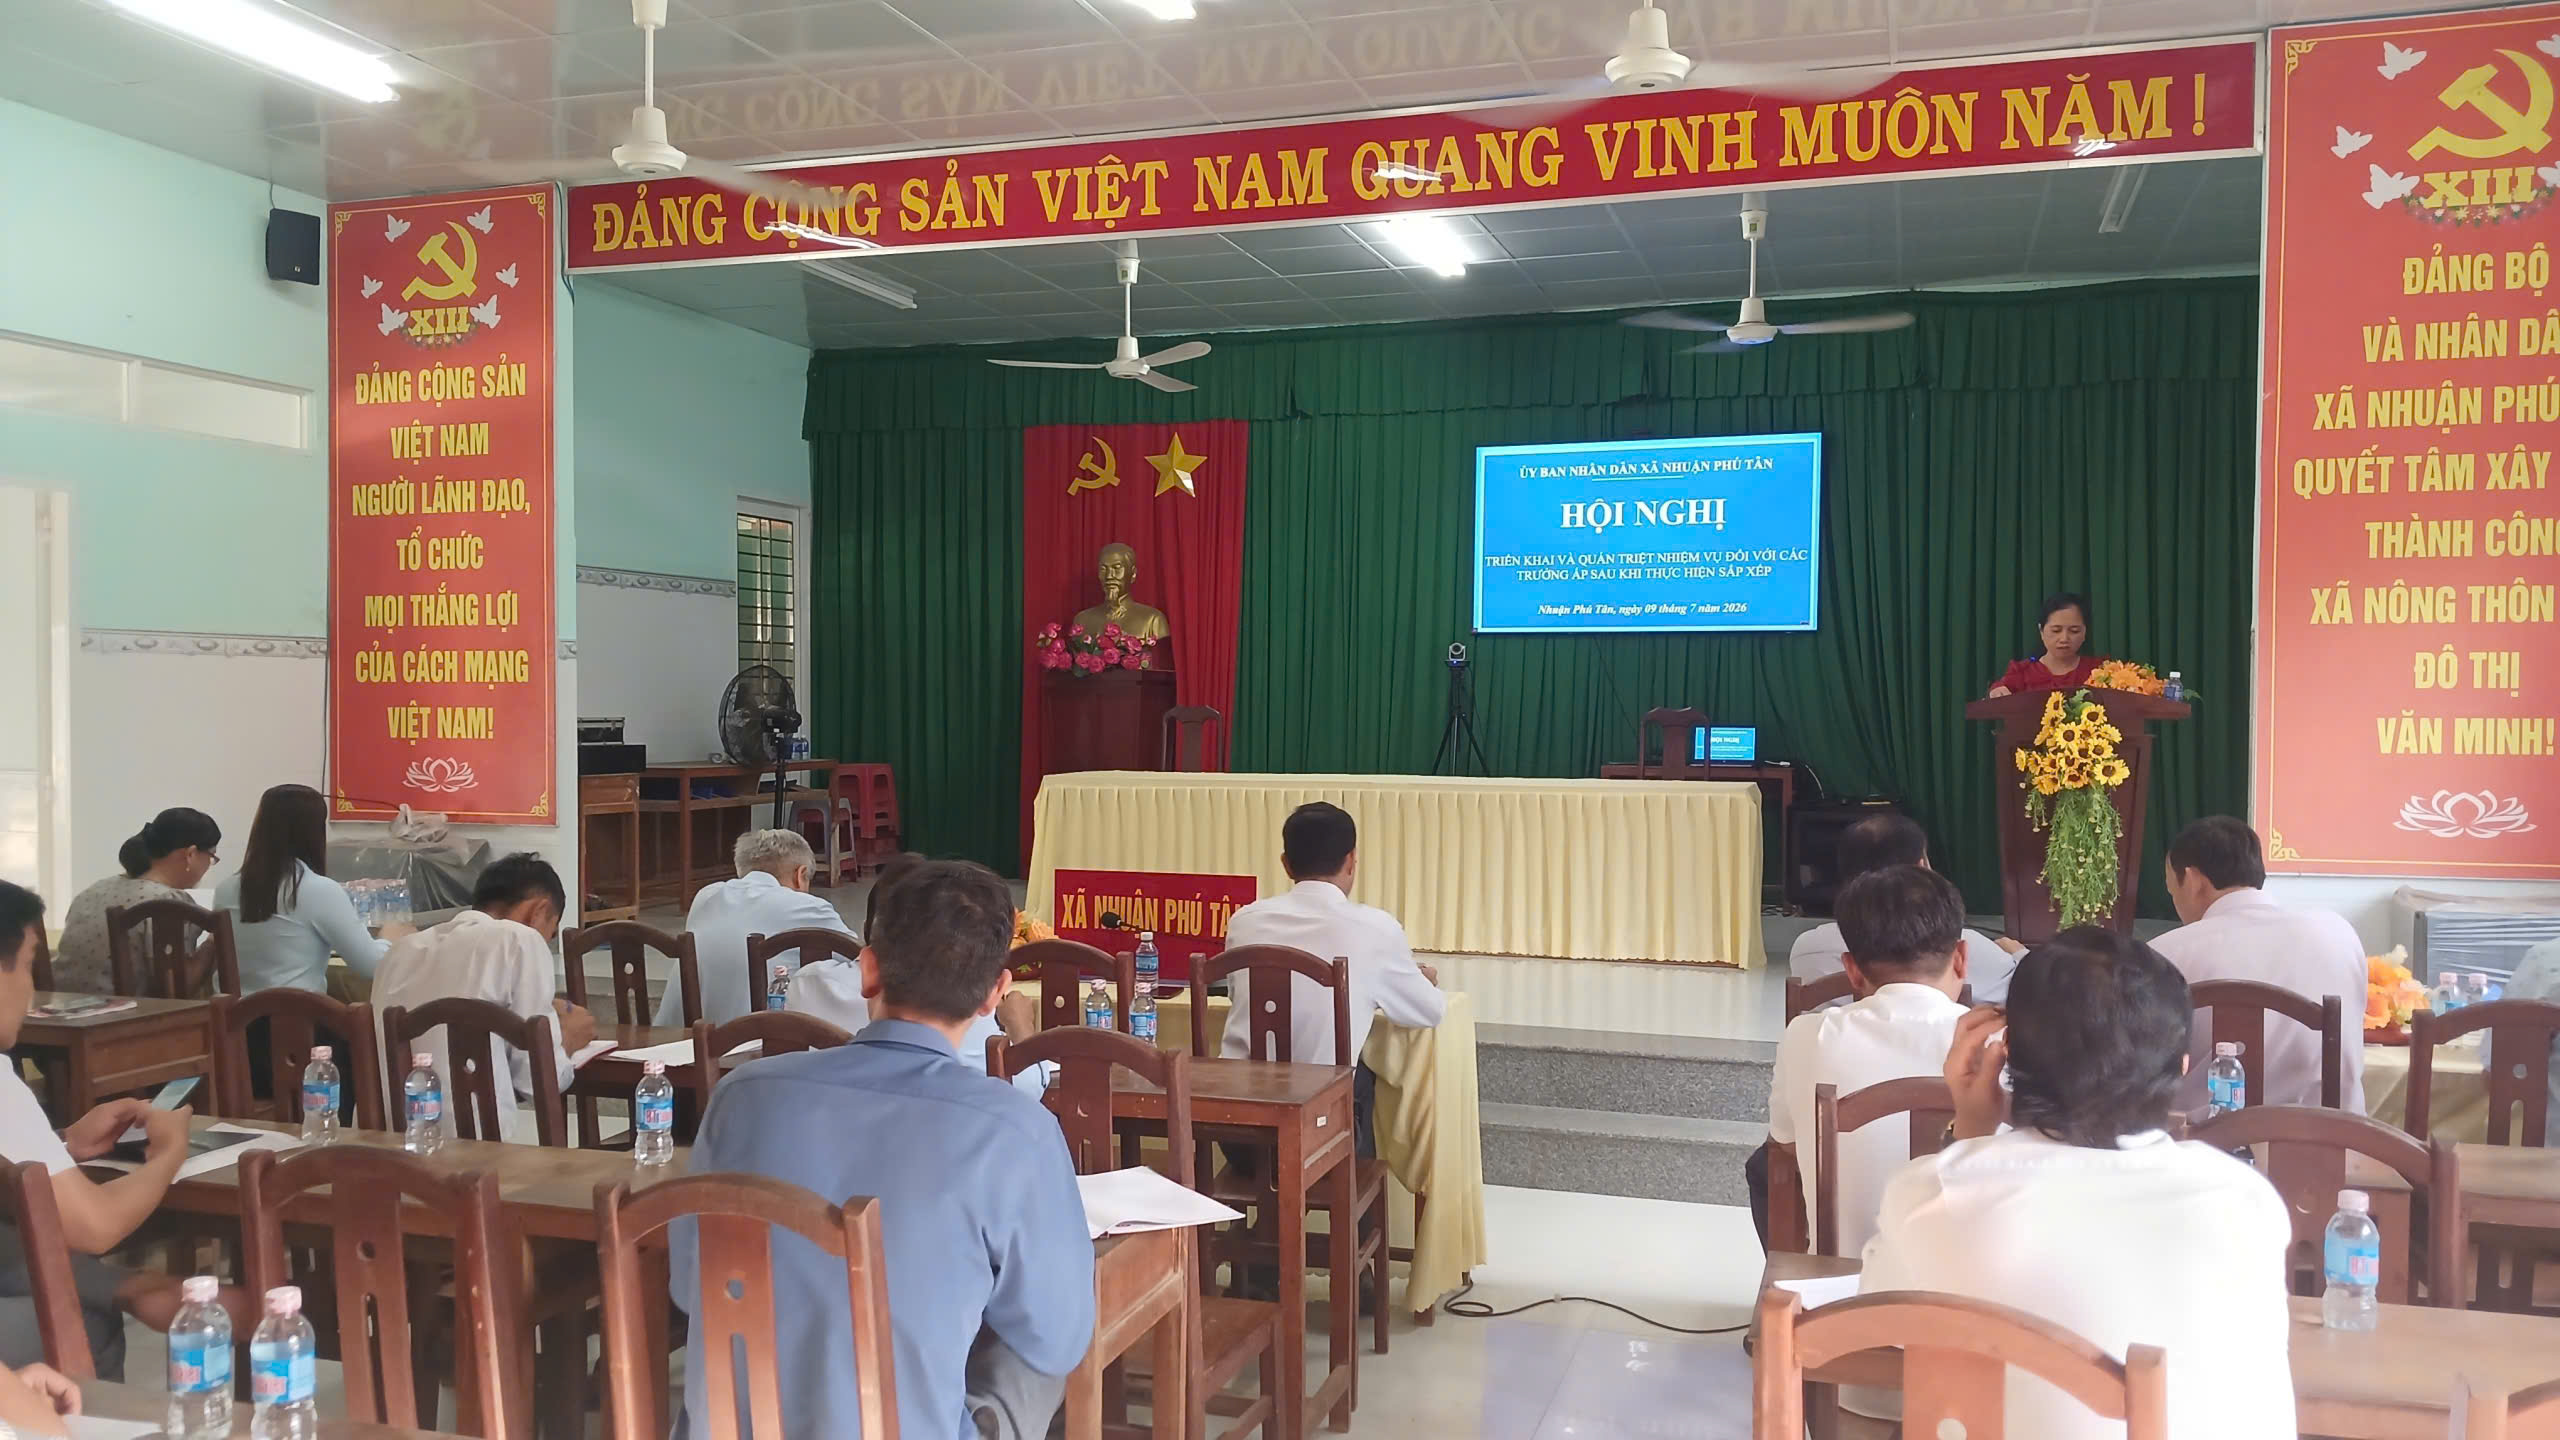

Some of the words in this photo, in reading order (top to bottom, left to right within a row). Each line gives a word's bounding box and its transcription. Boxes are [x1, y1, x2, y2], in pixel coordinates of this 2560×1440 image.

[593, 184, 727, 252] ĐẢNG
[744, 181, 881, 248] CỘNG
[899, 158, 1008, 232] SẢN
[1032, 154, 1168, 228] VIỆT
[1194, 148, 1328, 211] NAM
[1352, 127, 1564, 200] QUANG
[1585, 110, 1757, 181] VINH
[1779, 87, 1978, 167] MUÔN
[2001, 73, 2173, 150] NĂM
[2422, 166, 2536, 209] XIII
[2403, 243, 2494, 295] ĐẢNG
[2505, 241, 2549, 297] BỘ
[408, 306, 470, 336] XIII
[2362, 316, 2404, 363] VÀ
[2415, 312, 2508, 360] NHÂN
[355, 362, 411, 404] ĐẢNG
[418, 362, 475, 407] CỘNG
[482, 353, 526, 398] SẢN
[2313, 385, 2356, 431] XÃ
[2367, 379, 2482, 434] NHUẬN
[2493, 376, 2560, 424] PHÚ
[390, 419, 434, 465] VIỆT
[440, 423, 489, 457] NAM
[1540, 466, 1566, 478] BAN
[1569, 462, 1606, 476] NHÂN
[1609, 461, 1637, 474] DÂN
[1640, 460, 1659, 474] XÃ
[1662, 460, 1711, 474] NHUẬN
[1713, 457, 1741, 471] PHÚ
[1744, 456, 1774, 470] TÂN
[2293, 444, 2394, 500] QUYẾT
[2404, 446, 2475, 492] TÂM
[2485, 444, 2552, 490] XÂY
[352, 475, 414, 516] NGƯỜI
[422, 476, 475, 514] LÃNH
[482, 478, 530, 519] ĐẠO,
[1560, 498, 1625, 534] HỘI
[1634, 498, 1727, 530] NGHỊ
[396, 525, 422, 571] TỔ
[428, 530, 483, 570] CHỨC
[1523, 555, 1554, 566] KHAI
[1557, 552, 1575, 565] VÀ
[1618, 552, 1655, 565] TRIỆT
[1657, 551, 1700, 564] NHIỆM
[1703, 551, 1722, 563] VỤ
[1752, 548, 1776, 561] VỚI
[1779, 547, 1808, 560] CÁC
[2365, 512, 2473, 559] THÀNH
[2485, 510, 2560, 557] CÔN
[1590, 568, 1616, 579] SAU
[1619, 568, 1641, 578] KHI
[1645, 567, 1681, 579] THỰC
[1684, 566, 1715, 579] HIỆN
[365, 596, 404, 634] MỌI
[410, 582, 478, 626] THẮNG
[486, 591, 518, 633] LỢI
[1538, 604, 1571, 616] Nhuận
[1573, 604, 1592, 614] Phú
[1595, 604, 1616, 615] Tân,
[1619, 604, 1642, 616] ngày
[1645, 603, 1657, 613] 09
[1659, 603, 1687, 615] tháng
[1690, 603, 1697, 612] 7
[1698, 604, 1720, 613] năm
[1722, 603, 1747, 613] 2026
[2310, 580, 2353, 625] XÃ
[2364, 578, 2456, 624] NÔNG
[2467, 576, 2555, 623] THÔN
[355, 640, 397, 683] CỦA
[402, 643, 458, 683] CÁCH
[464, 650, 529, 690] MẠNG
[2414, 643, 2458, 689] ĐÔ
[2469, 651, 2520, 698] THỊ
[387, 700, 431, 746] VIỆT
[437, 707, 494, 739] NAM!
[2376, 709, 2443, 754] VĂN
[2454, 718, 2555, 755] MINH!
[1061, 888, 1087, 929] XÃ
[1165, 893, 1202, 936] PHÚ
[1209, 895, 1248, 937] TÂ
